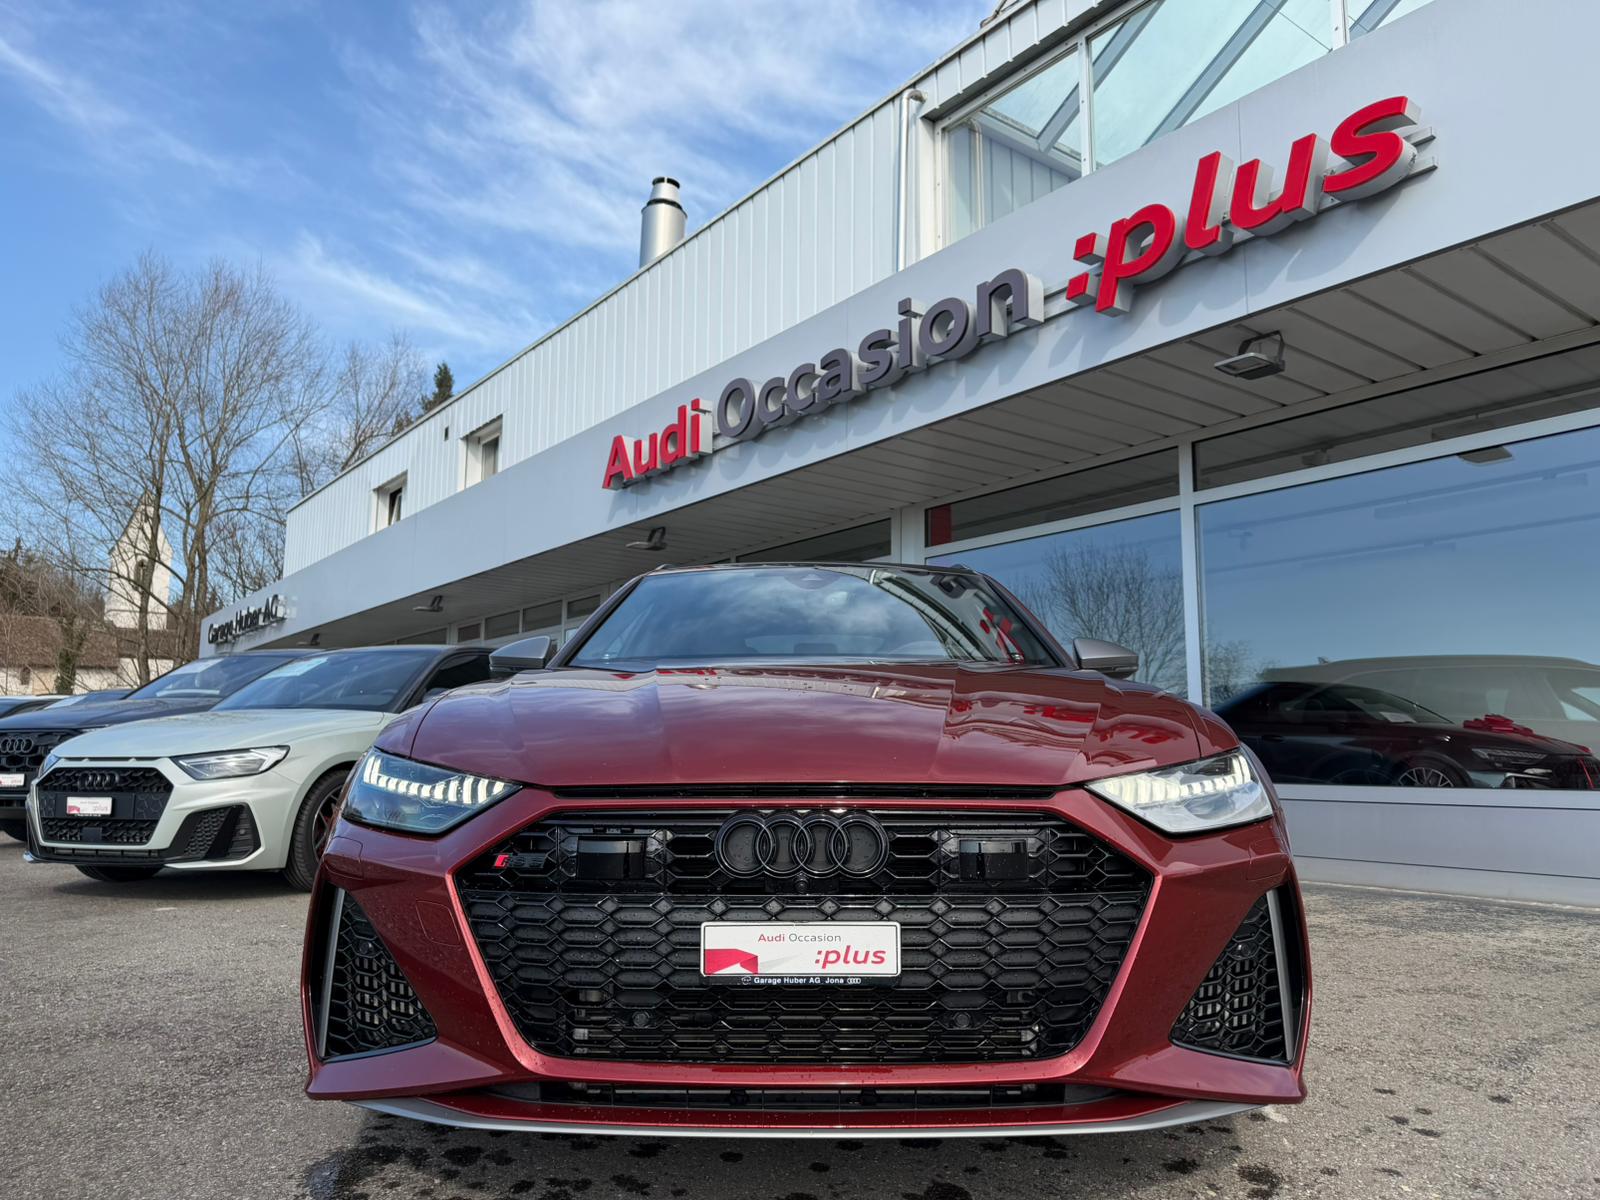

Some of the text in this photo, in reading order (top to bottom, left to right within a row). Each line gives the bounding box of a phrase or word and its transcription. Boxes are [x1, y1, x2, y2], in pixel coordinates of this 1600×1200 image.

[602, 397, 704, 489] Audi
[717, 268, 1034, 438] Occasion
[207, 594, 280, 644] Garage Huber AG
[758, 933, 842, 943] Audi Occasion
[815, 945, 886, 969] :plus
[754, 977, 781, 985] Garage
